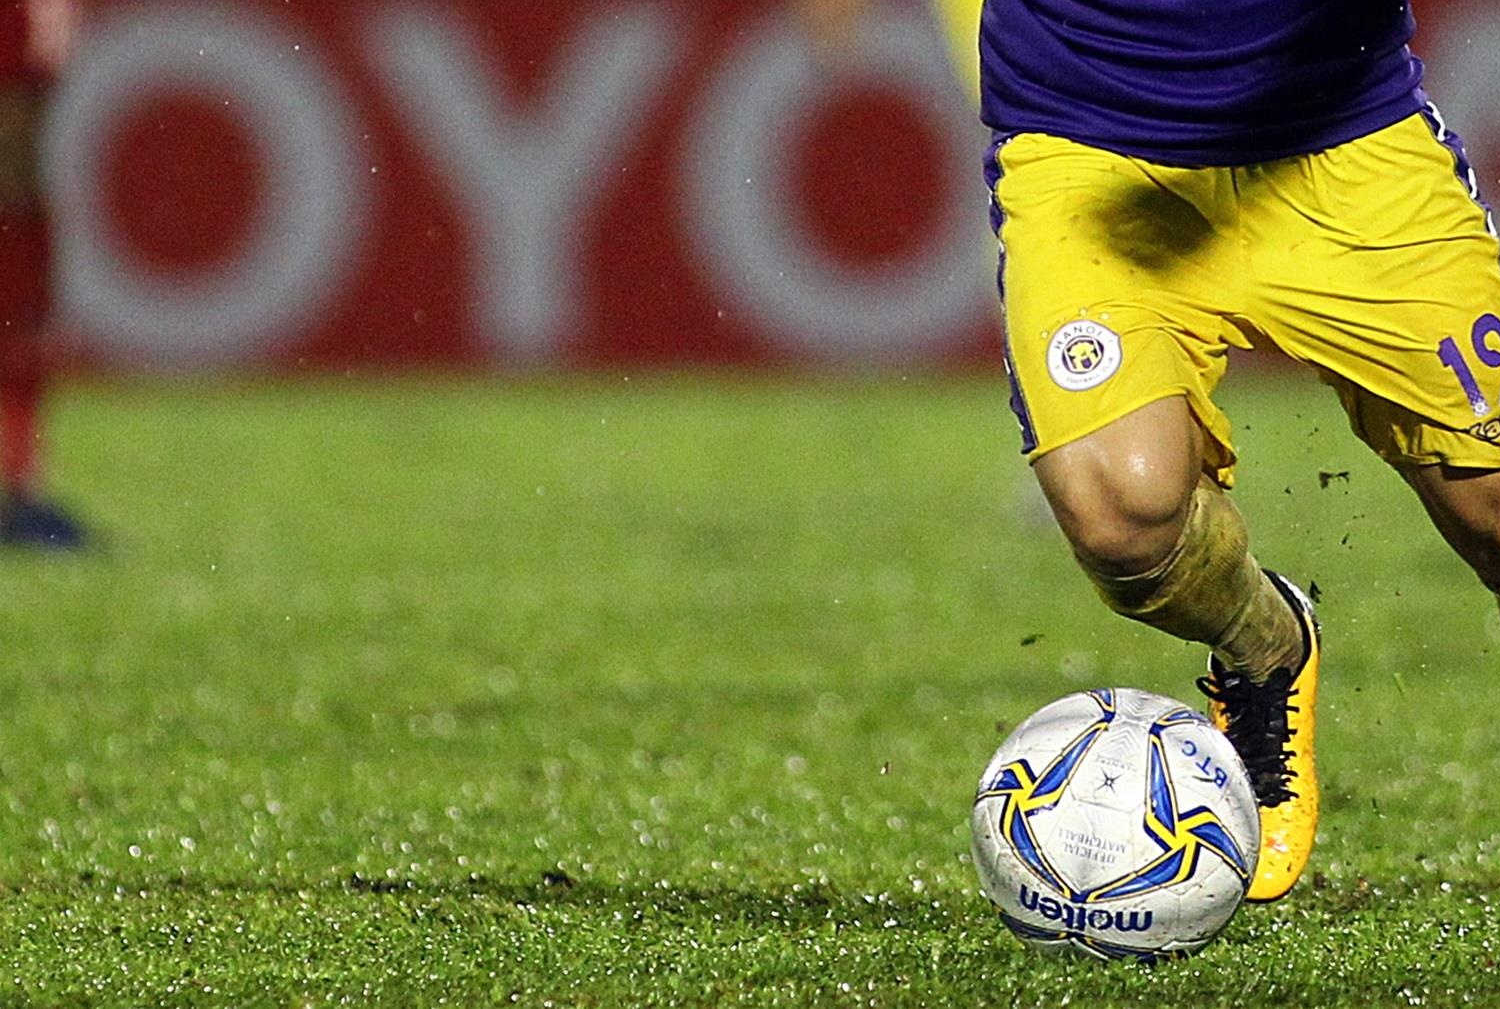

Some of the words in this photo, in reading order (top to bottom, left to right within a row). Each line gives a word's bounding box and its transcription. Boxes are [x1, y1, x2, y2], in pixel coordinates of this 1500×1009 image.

[1054, 324, 1103, 350] HANOI
[1181, 740, 1228, 789] BTC
[1062, 841, 1117, 864] OFFICIAL
[1019, 883, 1153, 932] molten
